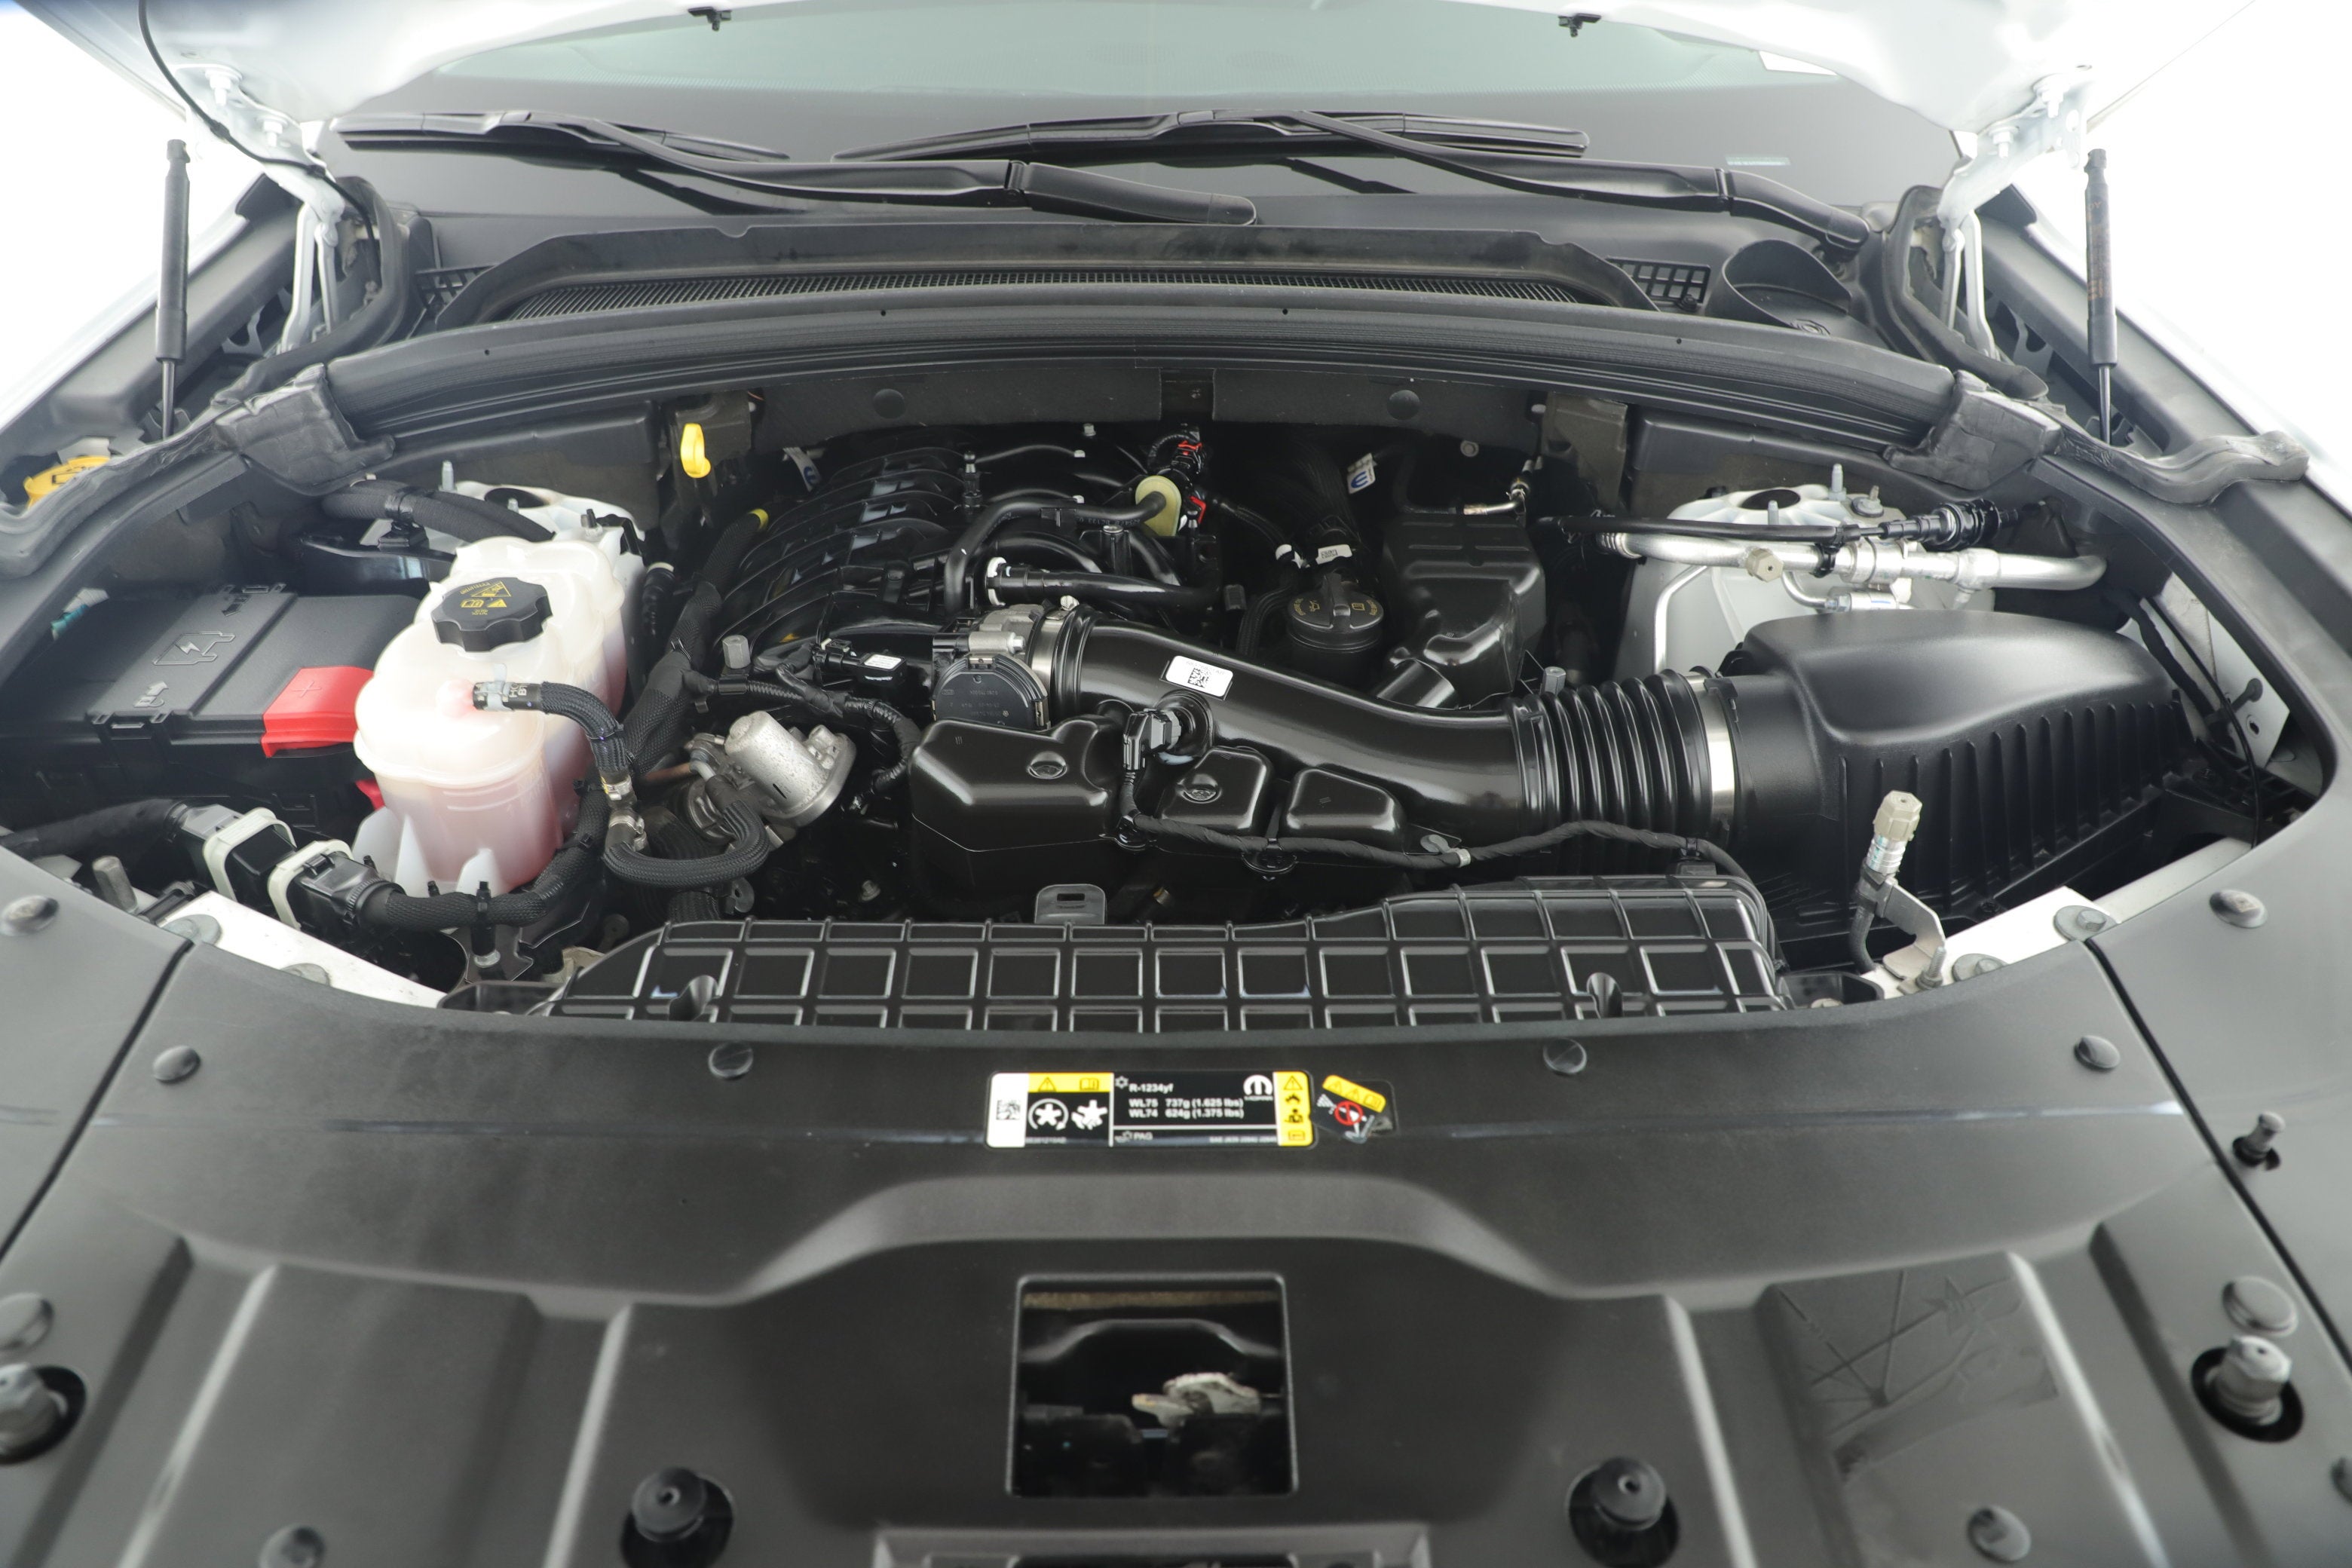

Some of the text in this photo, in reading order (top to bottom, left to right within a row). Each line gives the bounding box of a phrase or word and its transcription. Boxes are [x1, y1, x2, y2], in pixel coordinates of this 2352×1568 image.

[1129, 1083, 1174, 1095] R-1234yf
[1129, 1098, 1244, 1109] WL75 737g (1.625 lbs)
[1129, 1108, 1245, 1119] WL74 624g (1.375 lbs)
